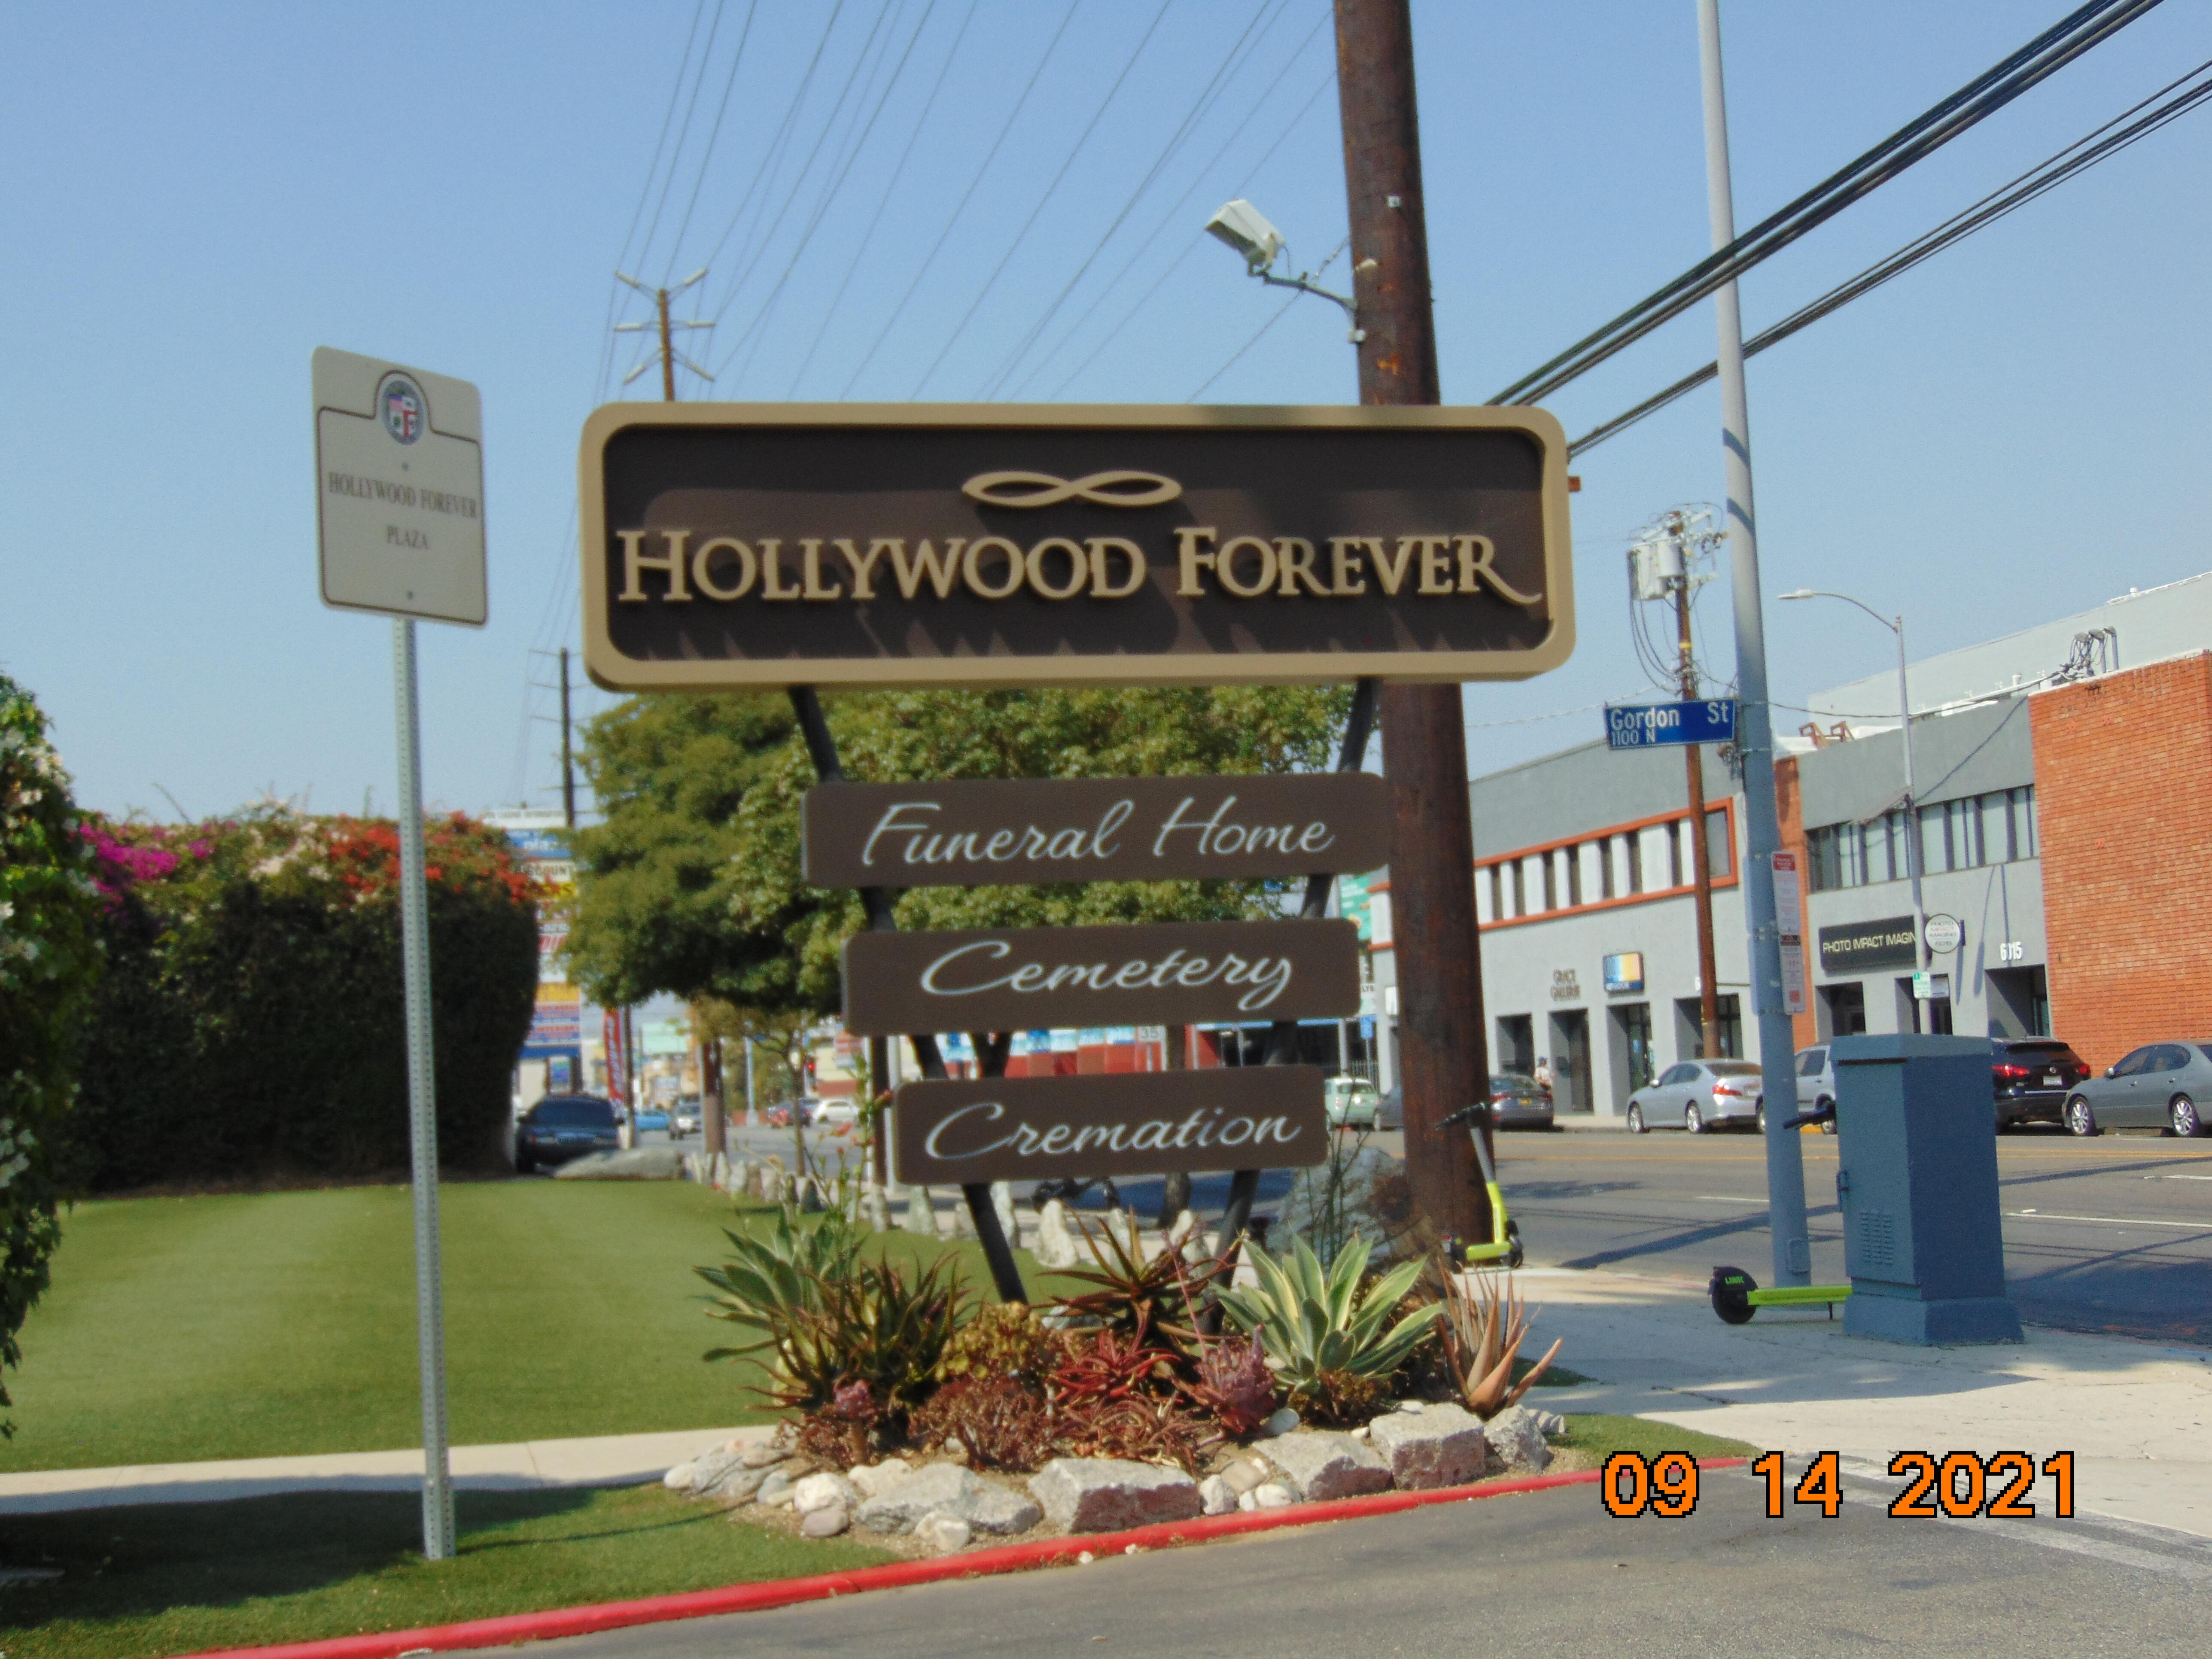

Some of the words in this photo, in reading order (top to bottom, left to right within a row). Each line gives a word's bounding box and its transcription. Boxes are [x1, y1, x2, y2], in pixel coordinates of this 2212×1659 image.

[328, 472, 416, 508] HOLLYWOOD
[420, 488, 476, 518] FOREVER
[387, 525, 429, 550] PLAZA
[616, 530, 1147, 601] HOLLYWOOD
[1174, 527, 1543, 605] FOREVER
[1611, 707, 1681, 730] Gordon
[1707, 701, 1729, 724] St
[1611, 730, 1639, 746] 1100
[1646, 728, 1656, 743] N
[862, 800, 1135, 866] Funeral
[1153, 794, 1336, 857] Home
[1823, 940, 1851, 953] PHOTO
[1853, 935, 1883, 949] IMPACT
[1886, 930, 1917, 946] IMAGIN
[920, 940, 1292, 1012] Cemetery
[925, 1101, 1302, 1160] Cremation
